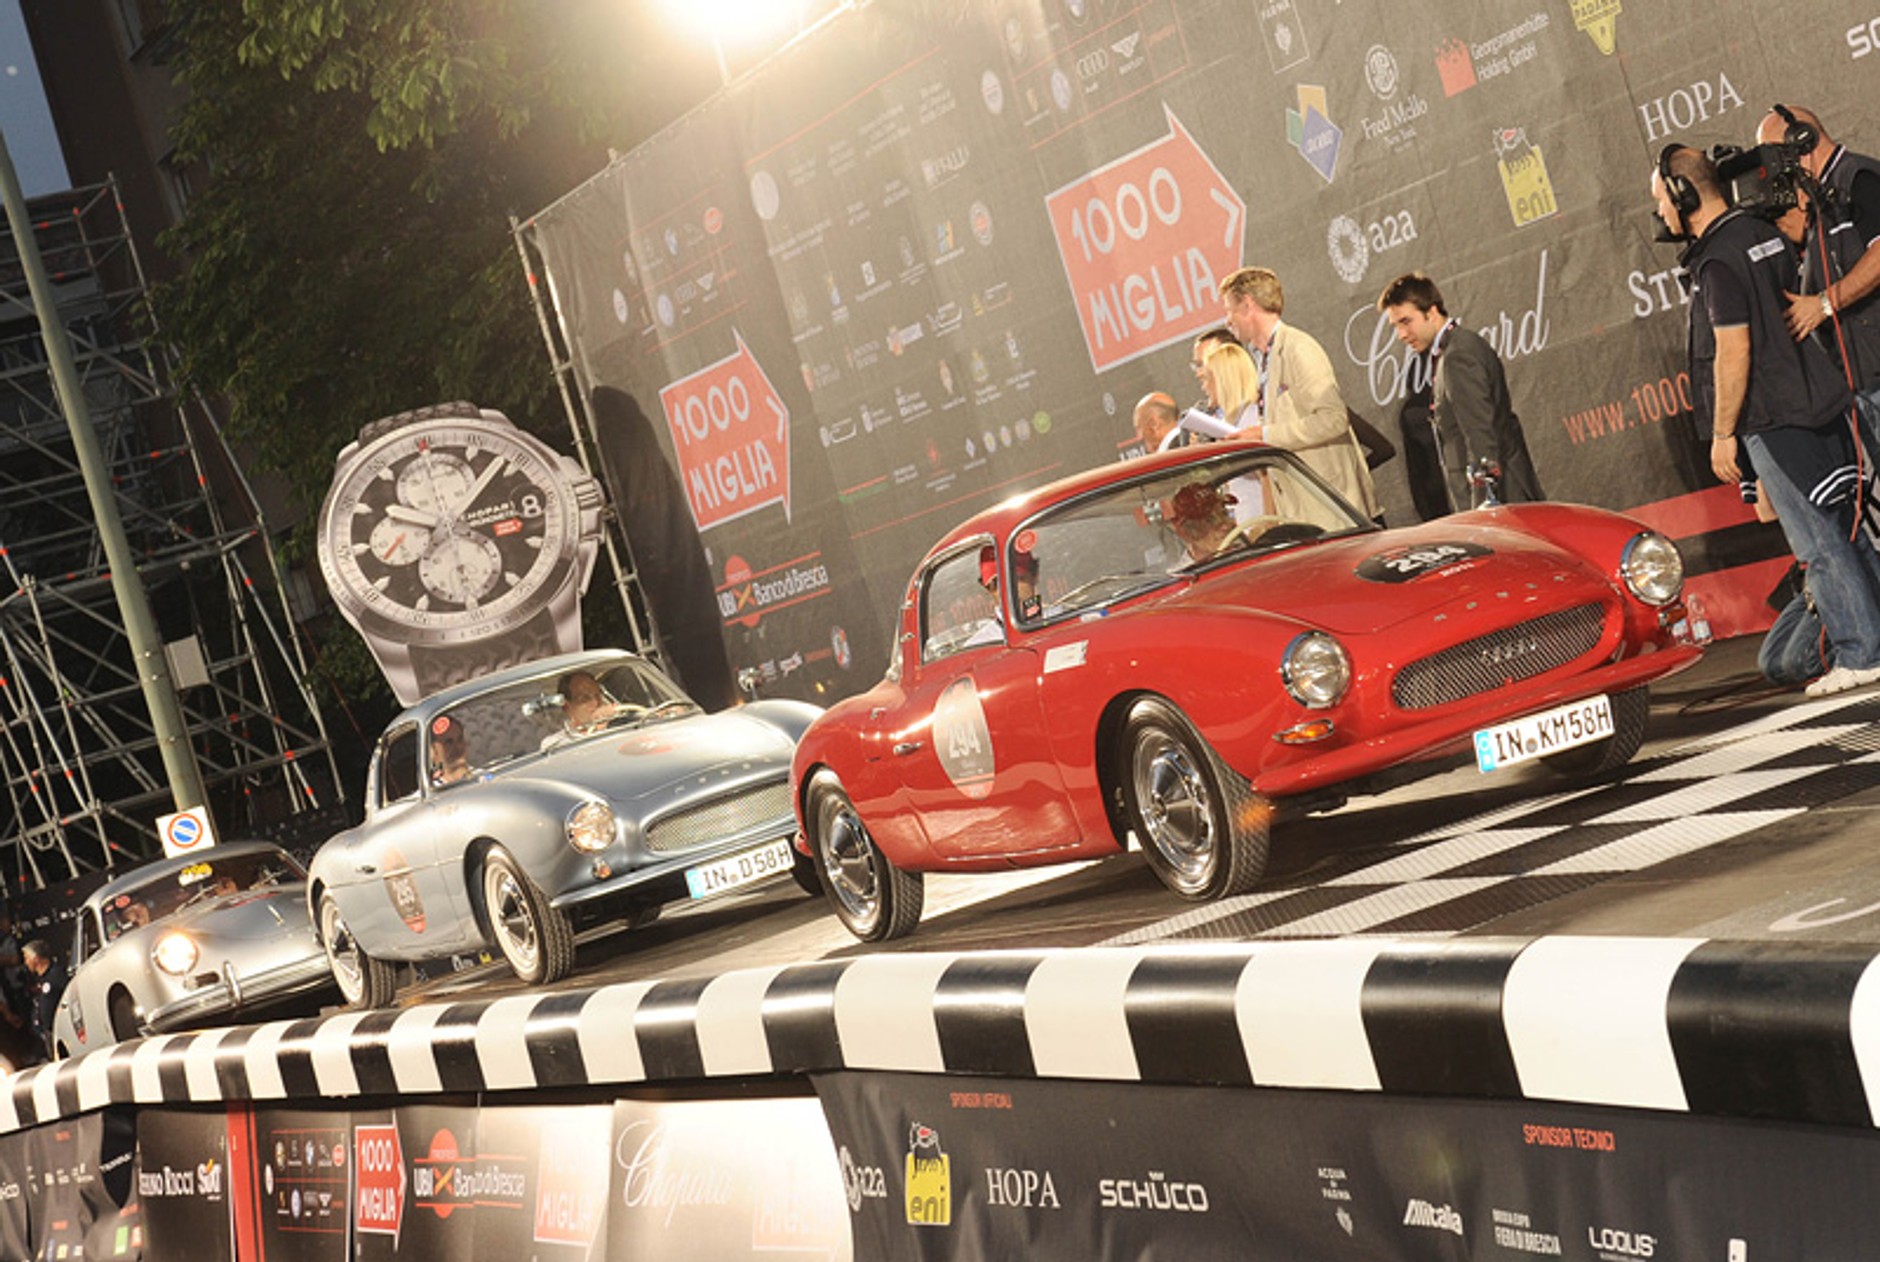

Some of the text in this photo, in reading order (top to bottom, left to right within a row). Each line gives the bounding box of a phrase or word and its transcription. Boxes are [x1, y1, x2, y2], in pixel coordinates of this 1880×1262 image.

[1361, 108, 1391, 140] Fred
[1638, 72, 1745, 142] HOPA
[1072, 167, 1182, 262] 1000
[1516, 177, 1553, 221] eni
[1369, 210, 1419, 252] a2a
[1089, 247, 1219, 350] MIGLIA
[674, 376, 750, 446] 1000
[689, 439, 777, 514] MIGLIA
[1494, 702, 1611, 762] IN KM58H
[703, 843, 791, 890] IN D58H
[361, 1138, 394, 1173] 1000
[1523, 1123, 1616, 1152] SPONSOR TECNICI
[360, 1187, 396, 1222] MIGLIA
[909, 1185, 946, 1222] eni
[986, 1167, 1061, 1208] HOPA
[1099, 1171, 1209, 1212] SCHÜCO
[1403, 1199, 1463, 1236] Alitalia
